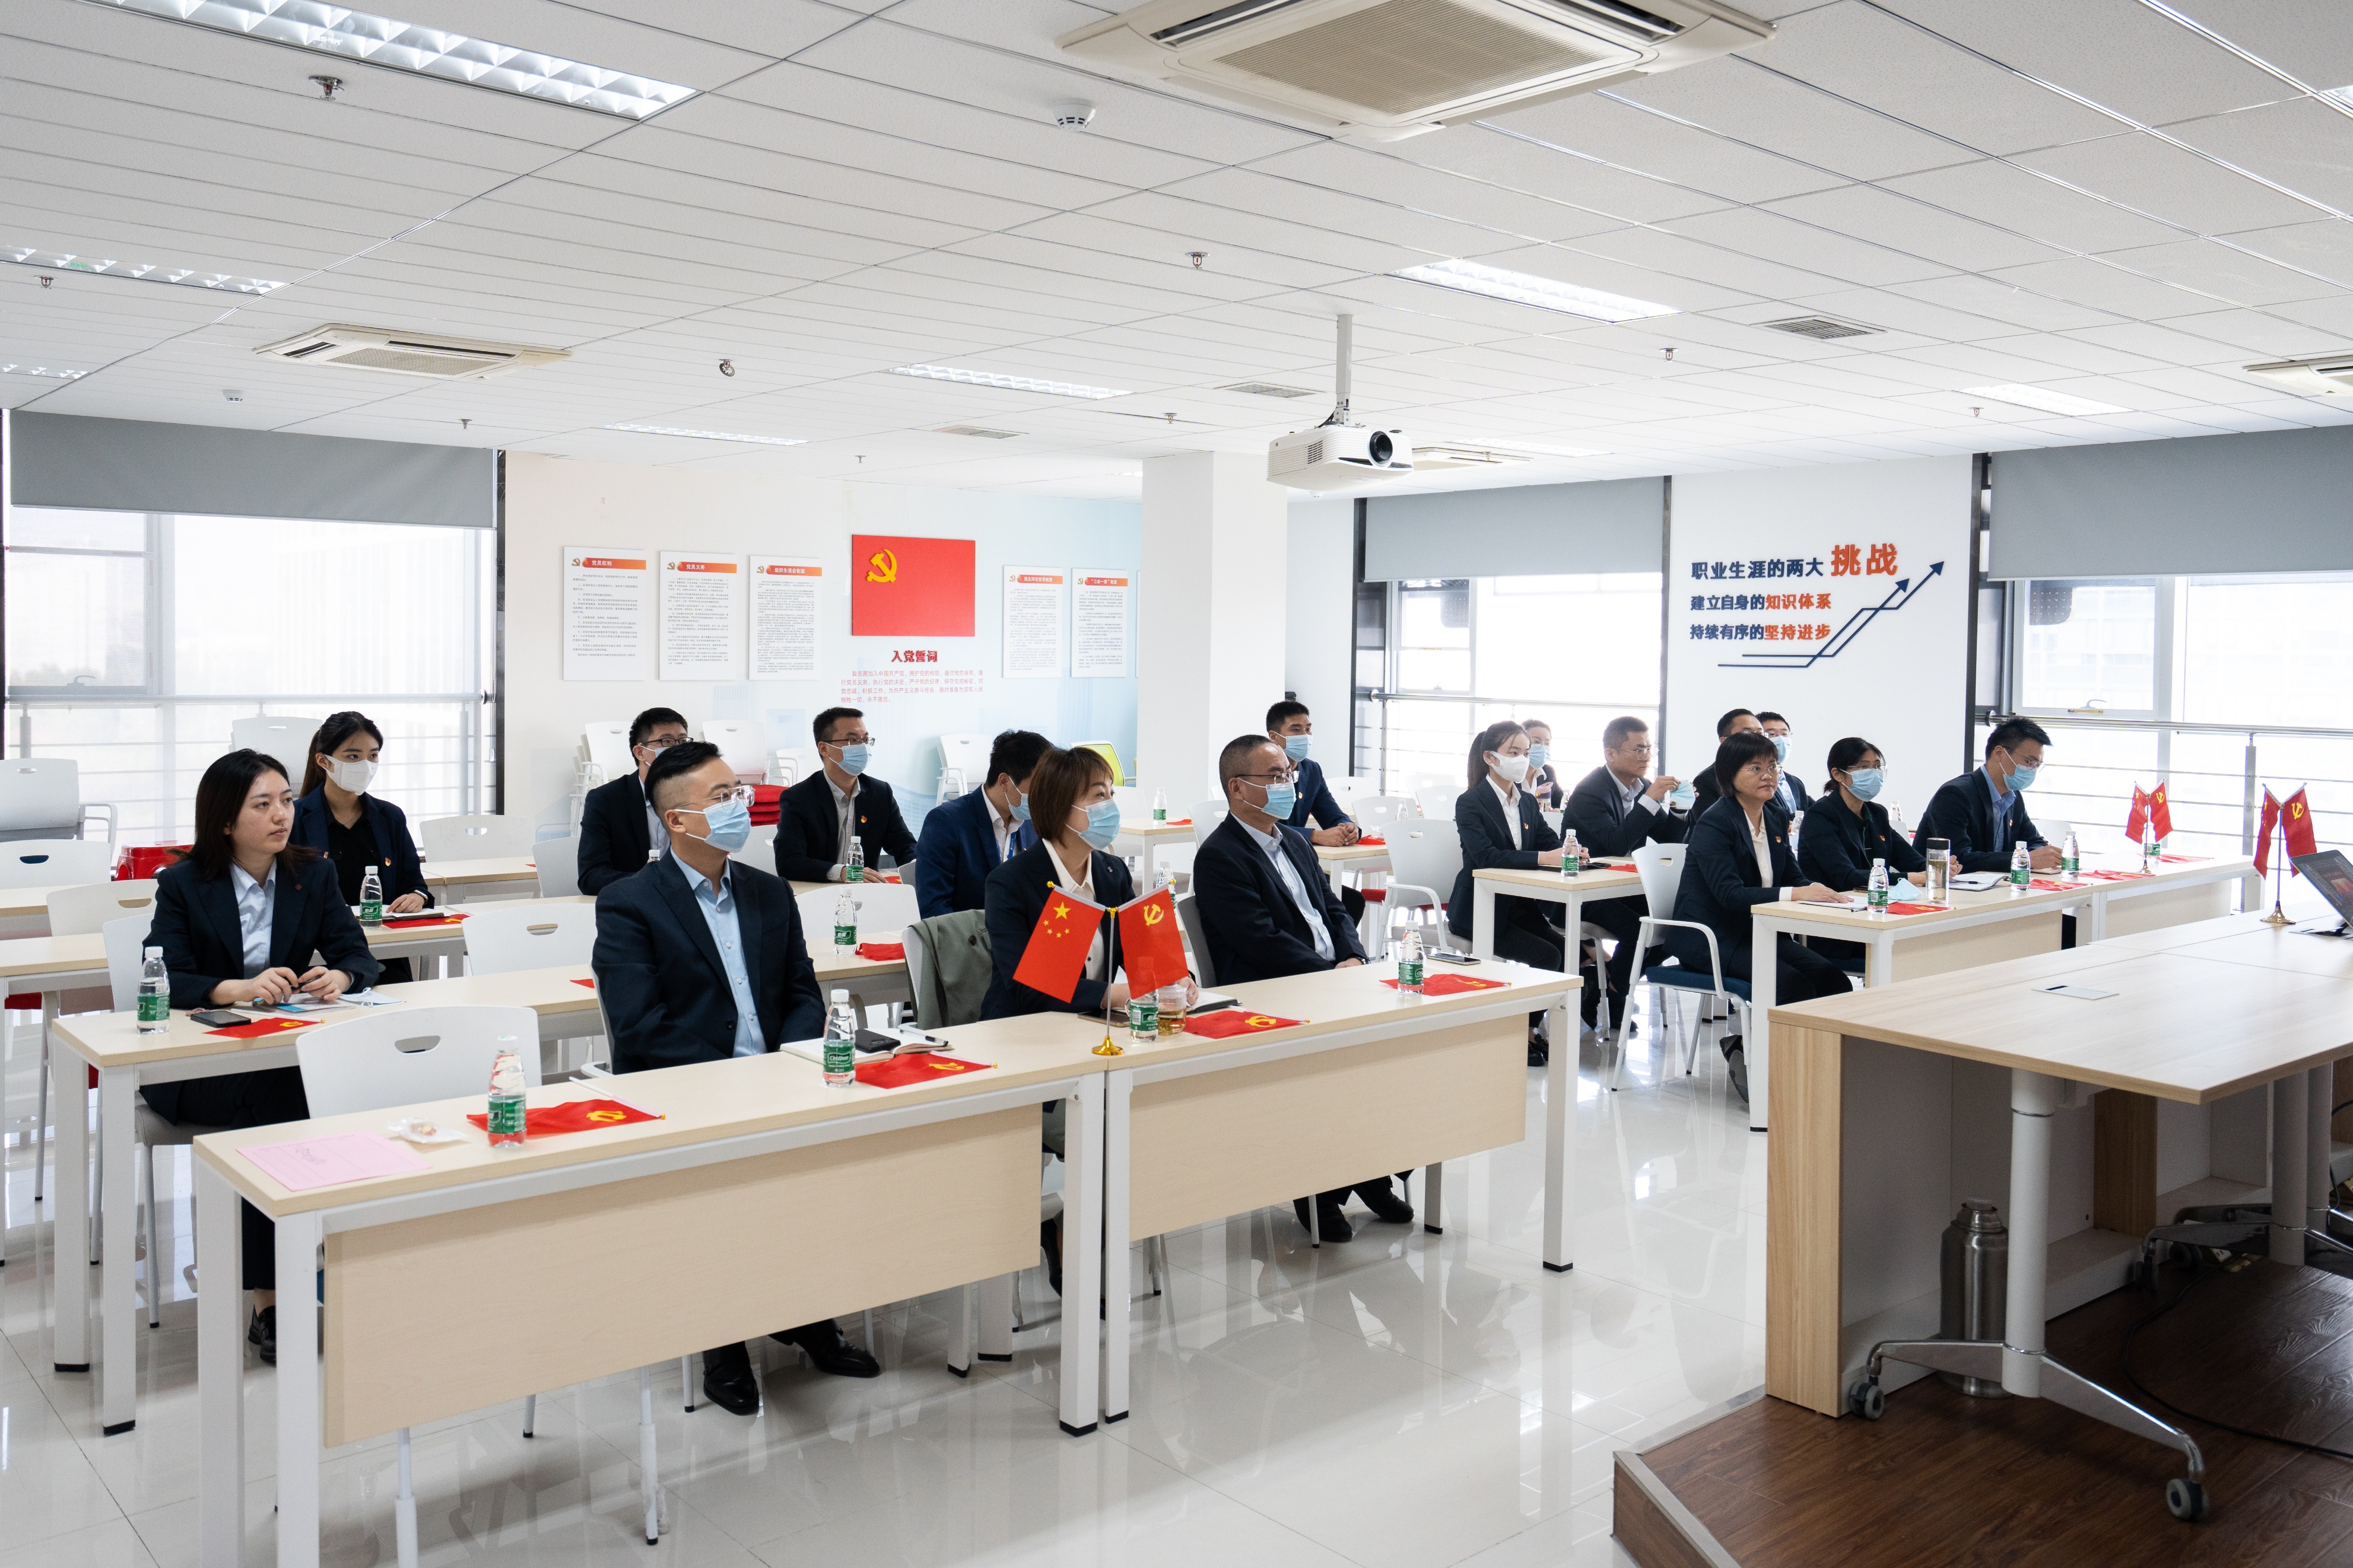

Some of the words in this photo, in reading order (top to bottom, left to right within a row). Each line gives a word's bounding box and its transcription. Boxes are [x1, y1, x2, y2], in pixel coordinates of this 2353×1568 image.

[1691, 593, 1831, 610] 建立自身的知识体系
[1690, 623, 1831, 640] 持续有序的坚持进步
[891, 650, 938, 663] 入党誓词
